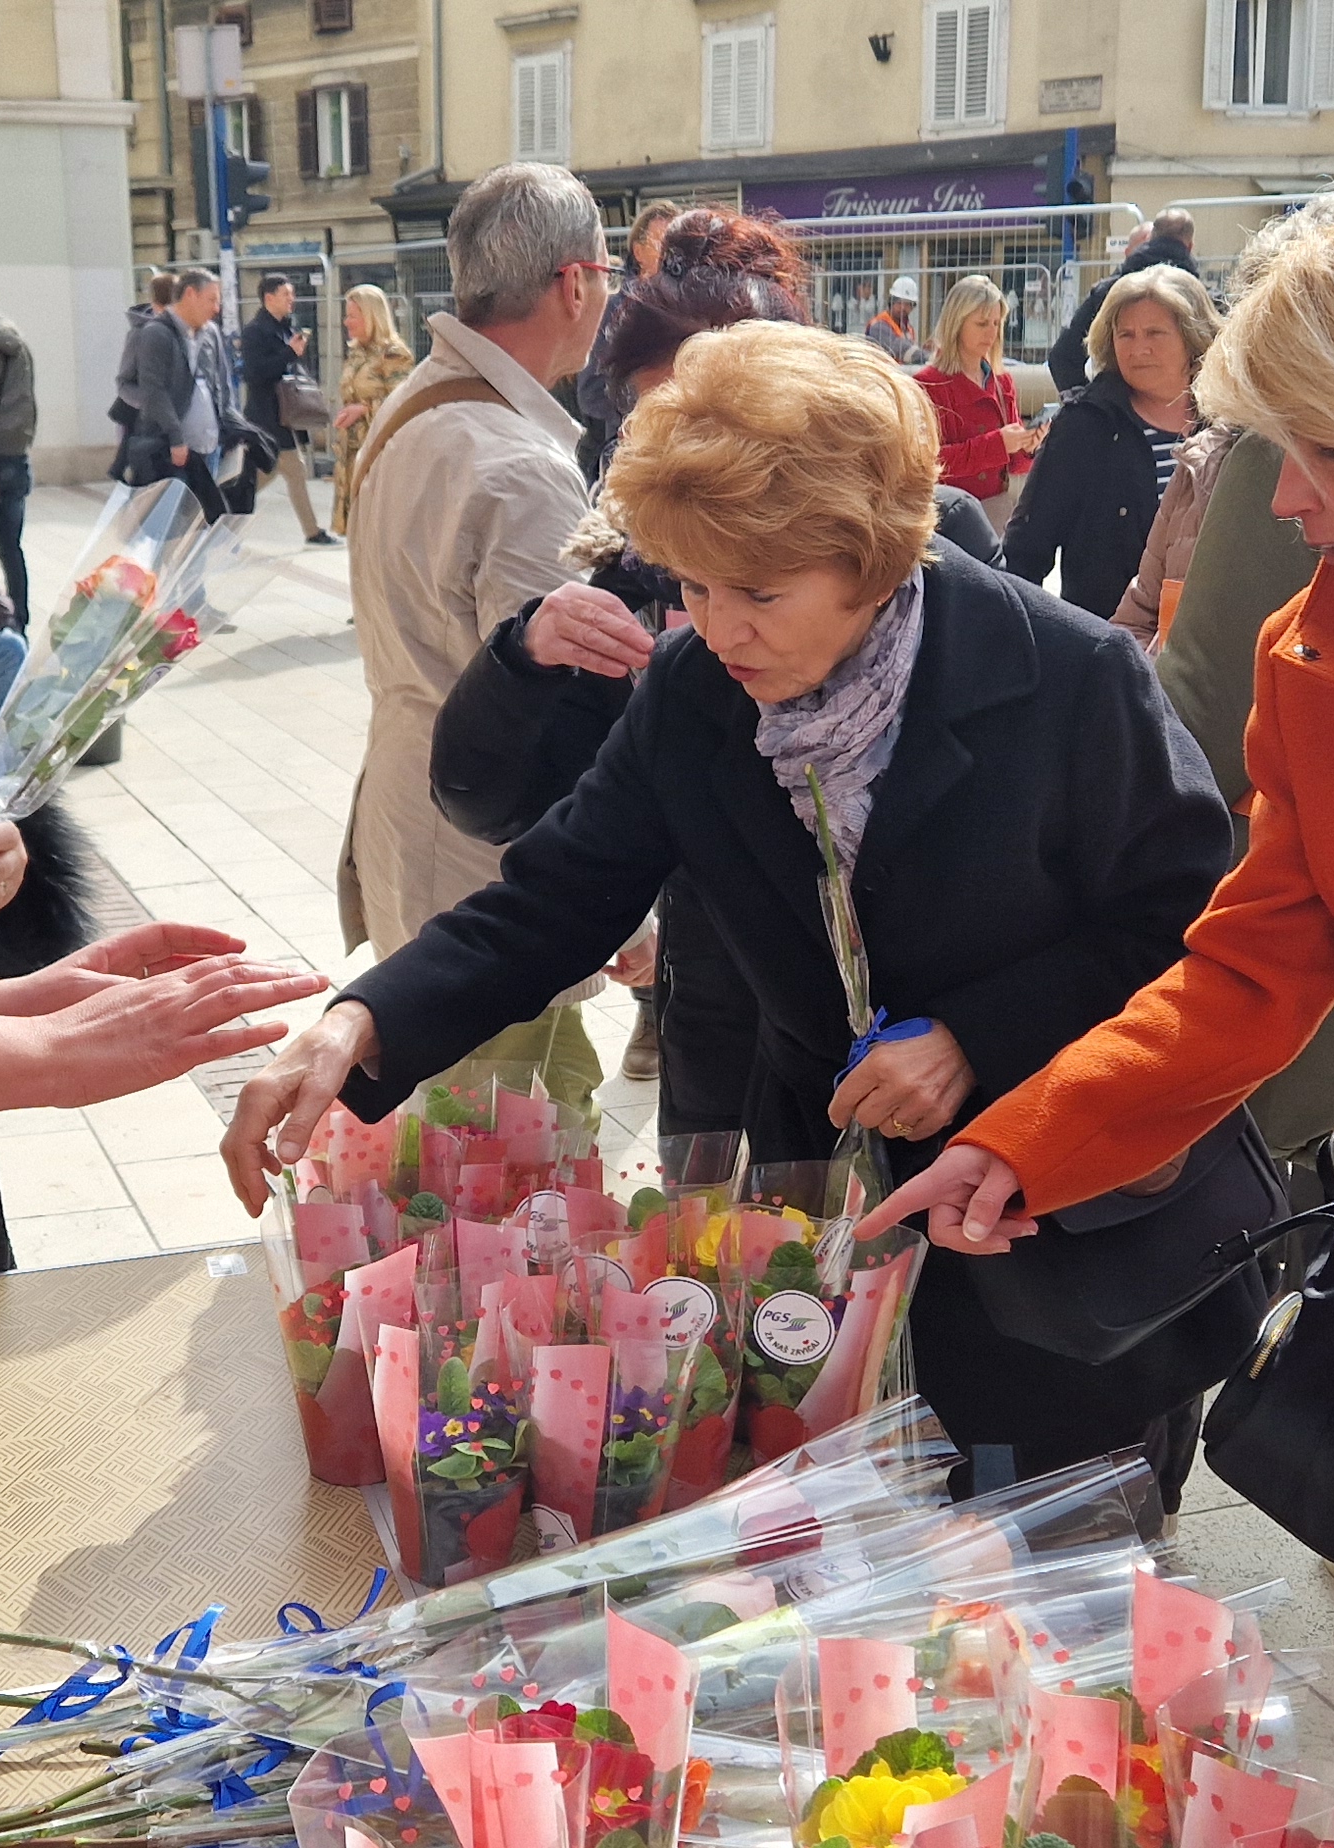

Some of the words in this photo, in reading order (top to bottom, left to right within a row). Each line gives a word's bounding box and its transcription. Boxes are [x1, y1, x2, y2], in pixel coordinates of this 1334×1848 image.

[821, 187, 920, 218] Friseur
[927, 179, 985, 212] Iris
[762, 1310, 791, 1323] PGS
[764, 1331, 774, 1341] ZA
[772, 1341, 789, 1354] NAŠ
